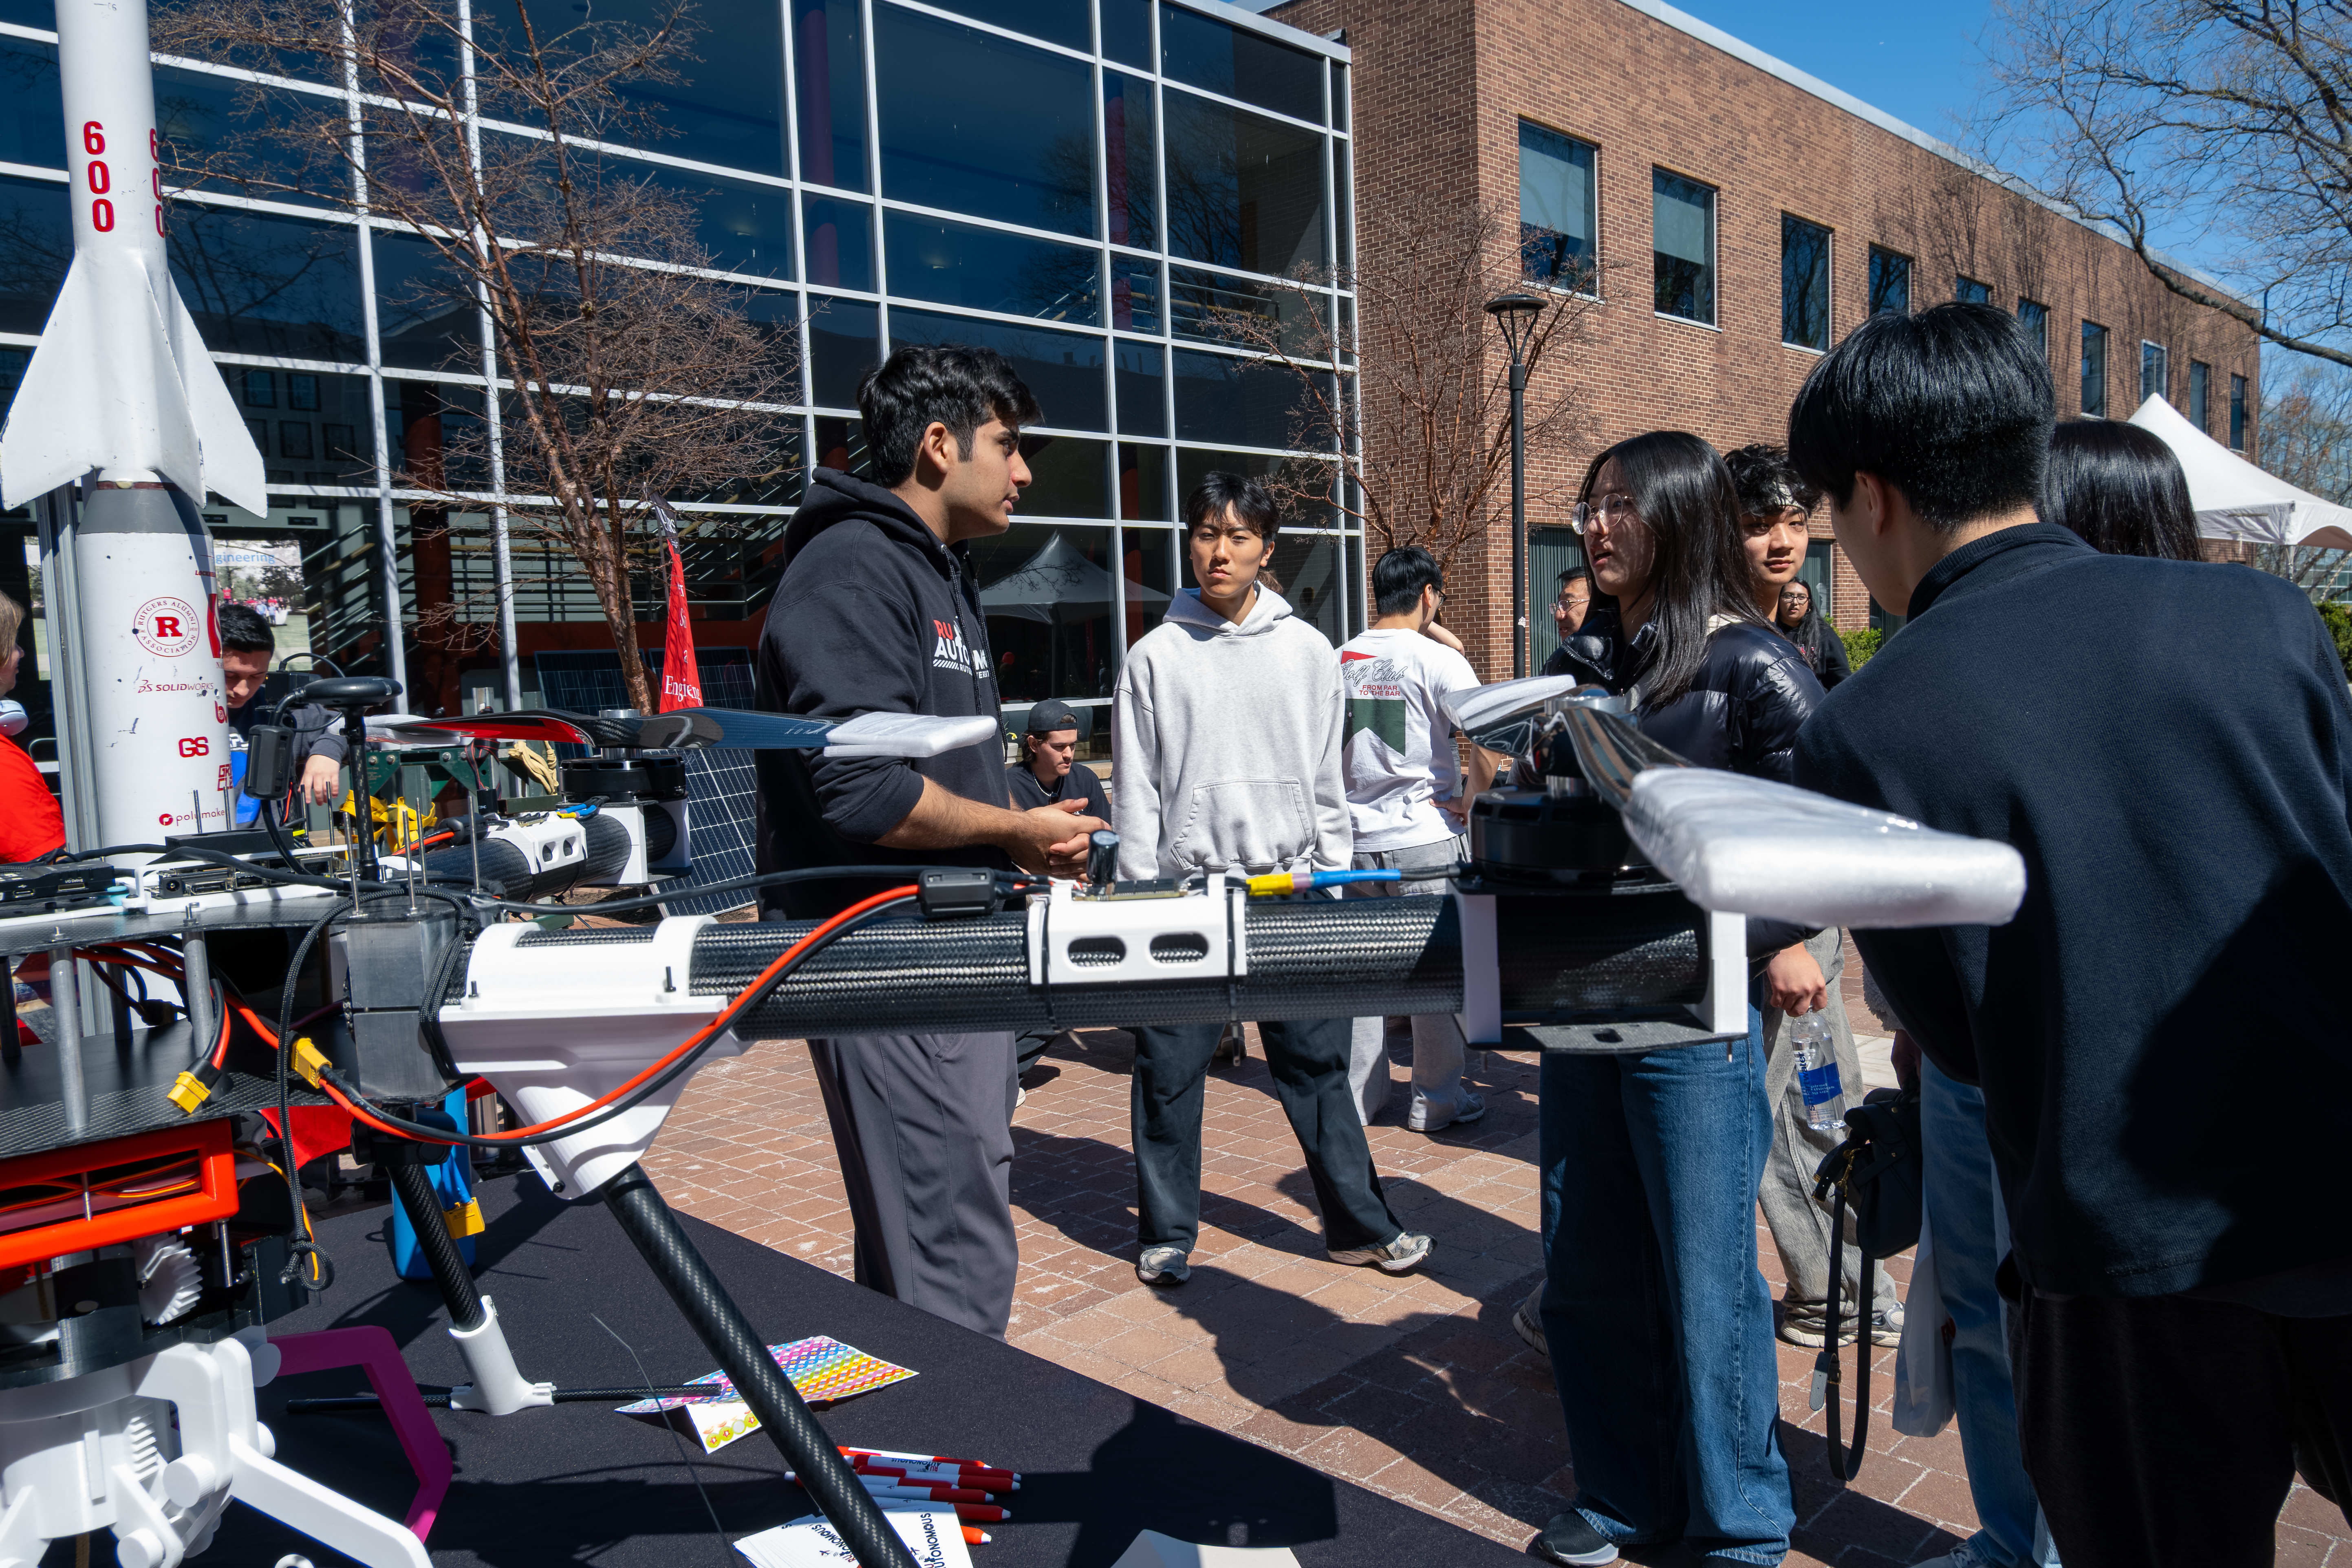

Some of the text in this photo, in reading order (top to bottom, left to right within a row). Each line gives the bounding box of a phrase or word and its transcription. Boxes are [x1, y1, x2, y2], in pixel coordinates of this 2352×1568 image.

[83, 121, 115, 232] 600
[150, 128, 165, 238] 600
[215, 552, 275, 565] gineering
[138, 600, 196, 625] RUTGERS ALUMNI
[155, 616, 183, 637] R
[934, 620, 953, 640] RU
[141, 635, 196, 653] ASSOCIATION
[1340, 659, 1408, 687] Golf Club
[156, 682, 214, 691] SOLIDWORKS
[179, 736, 209, 758] GS
[176, 807, 225, 826] polmake
[920, 1513, 946, 1568] UTONOMOUS
